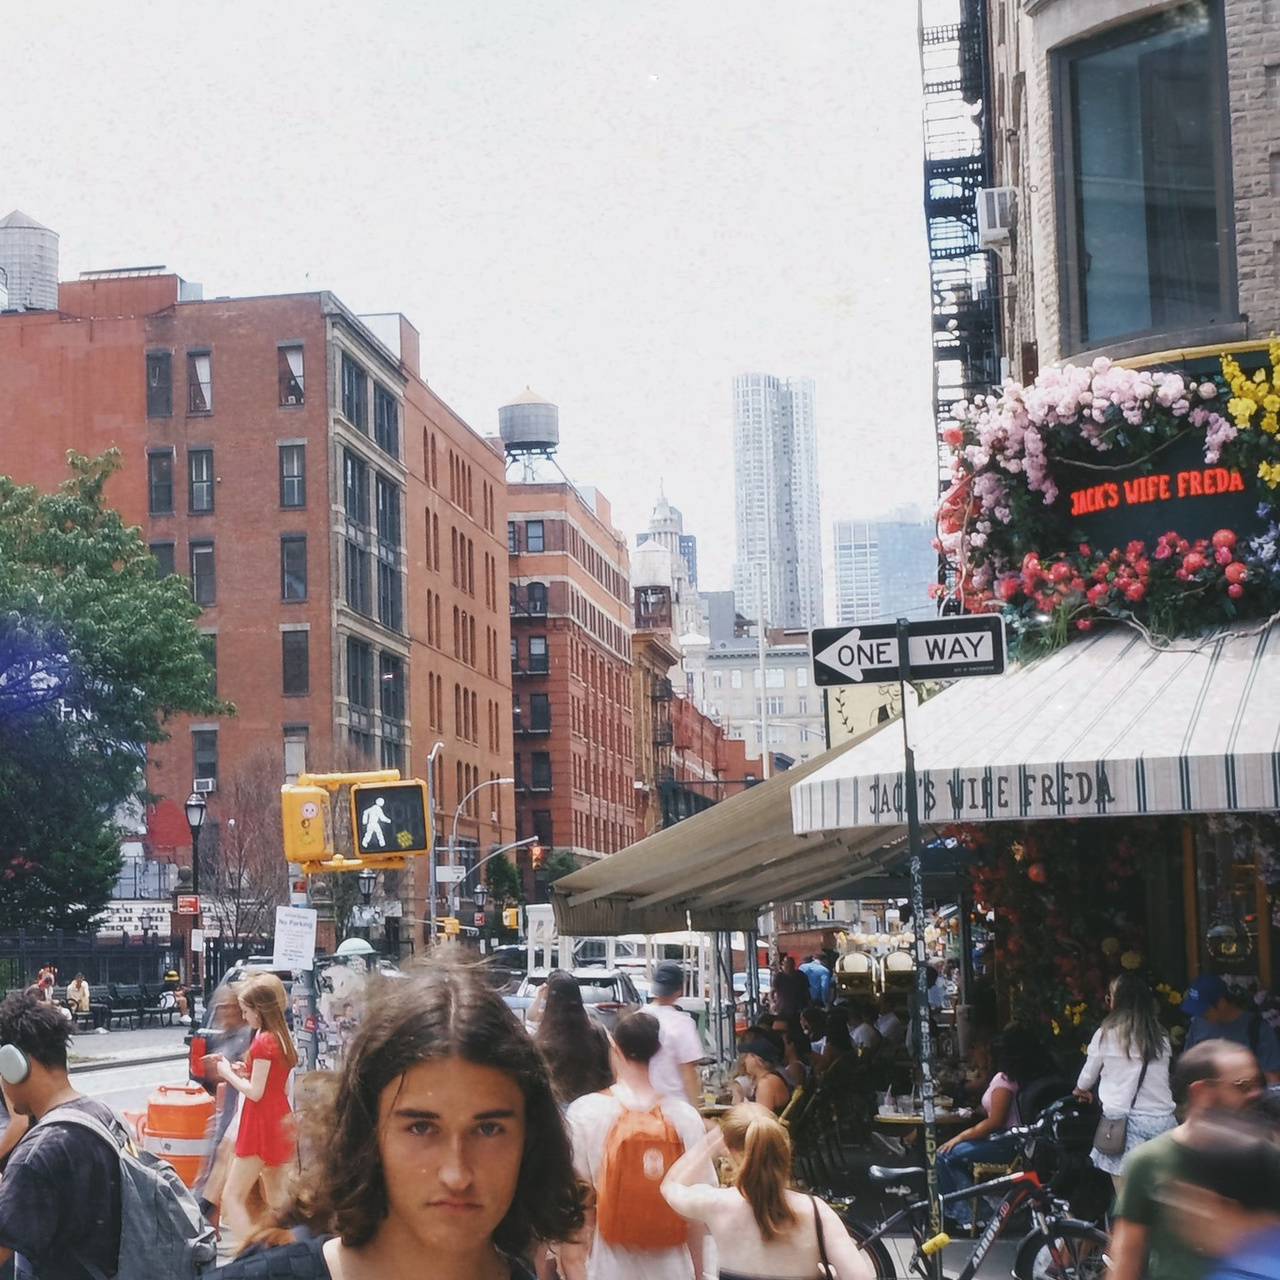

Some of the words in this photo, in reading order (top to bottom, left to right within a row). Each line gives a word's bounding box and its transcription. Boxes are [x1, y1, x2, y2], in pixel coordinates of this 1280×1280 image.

[1070, 482, 1119, 516] JACK'S
[1123, 474, 1171, 504] WIFE
[1177, 467, 1245, 498] FREDA
[838, 642, 892, 667] ONE
[925, 634, 985, 661] WAY
[869, 779, 936, 814] JAC'S
[947, 775, 1009, 810] WIFE
[1024, 768, 1116, 808] FREDA
[289, 920, 313, 929] Parking
